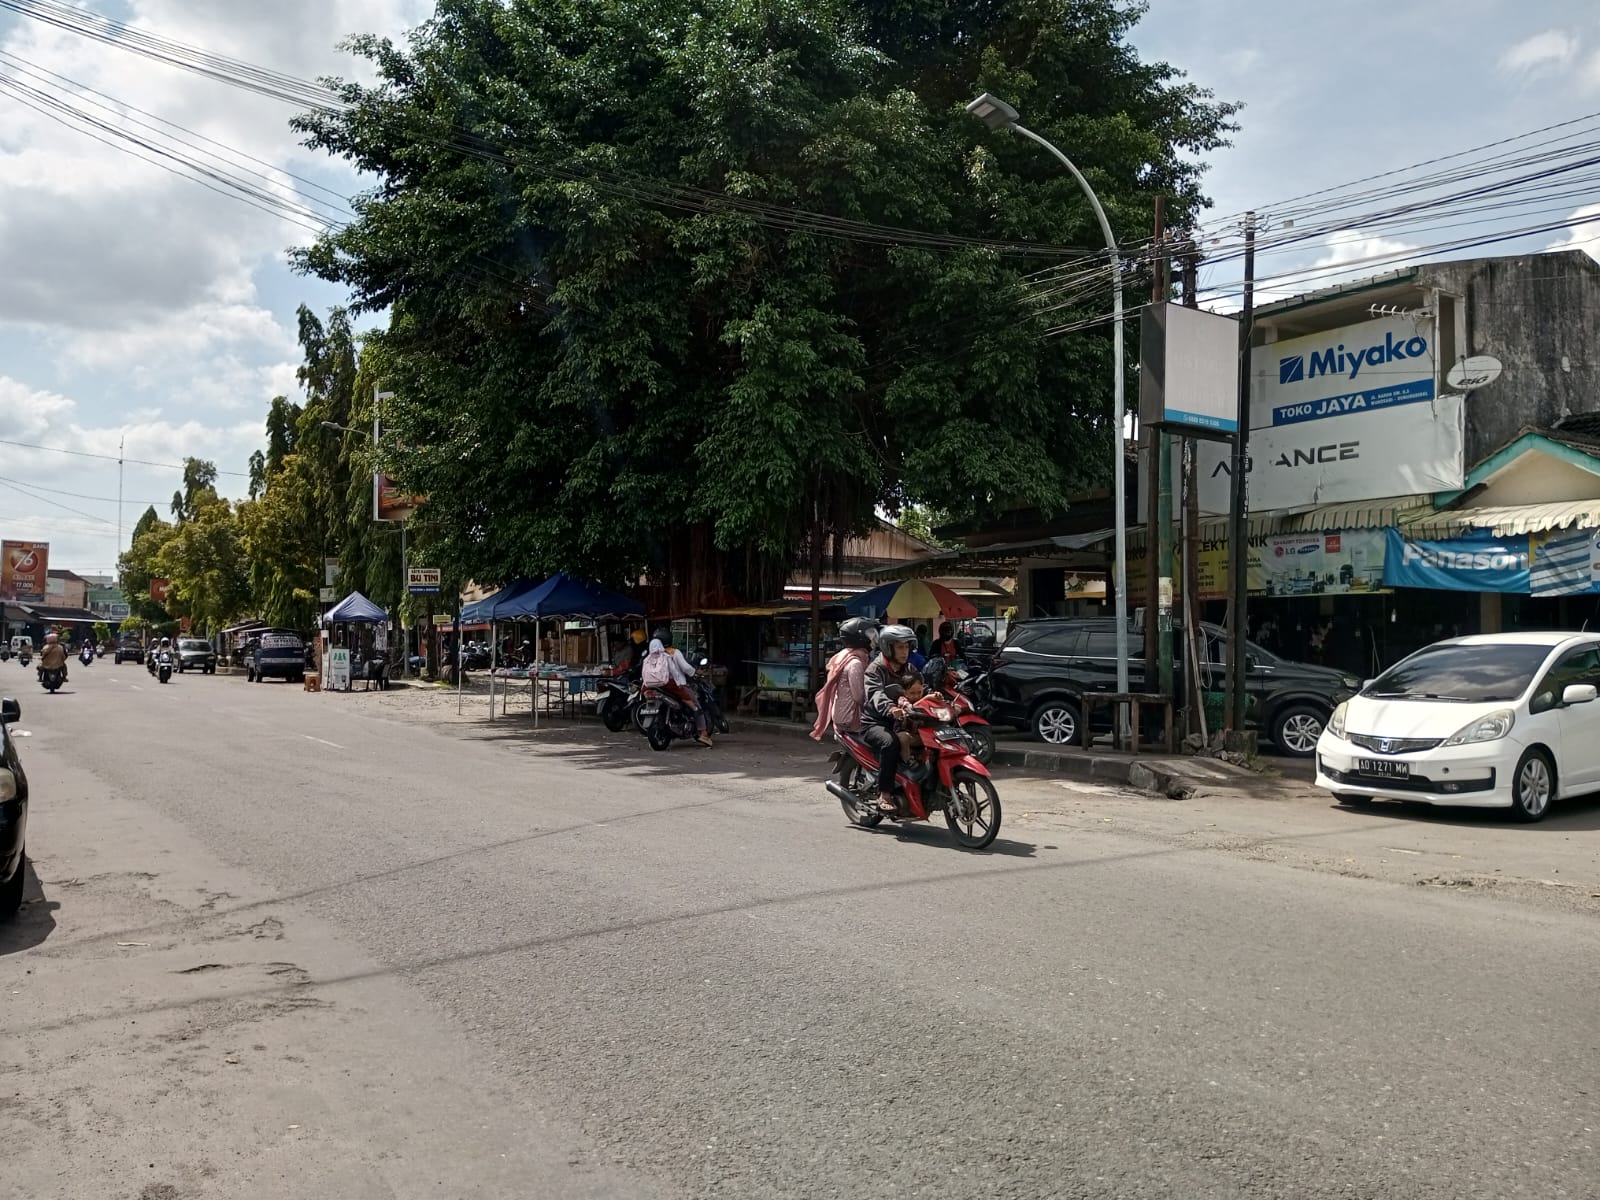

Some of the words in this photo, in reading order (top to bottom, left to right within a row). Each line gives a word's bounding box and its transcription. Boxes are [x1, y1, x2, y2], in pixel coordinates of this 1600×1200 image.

[1308, 332, 1427, 379] Miyako
[1279, 405, 1312, 419] TOKO
[1316, 394, 1366, 415] JAYA
[411, 574, 422, 582] BU
[423, 574, 439, 582] TINI
[1372, 760, 1392, 772] 1271
